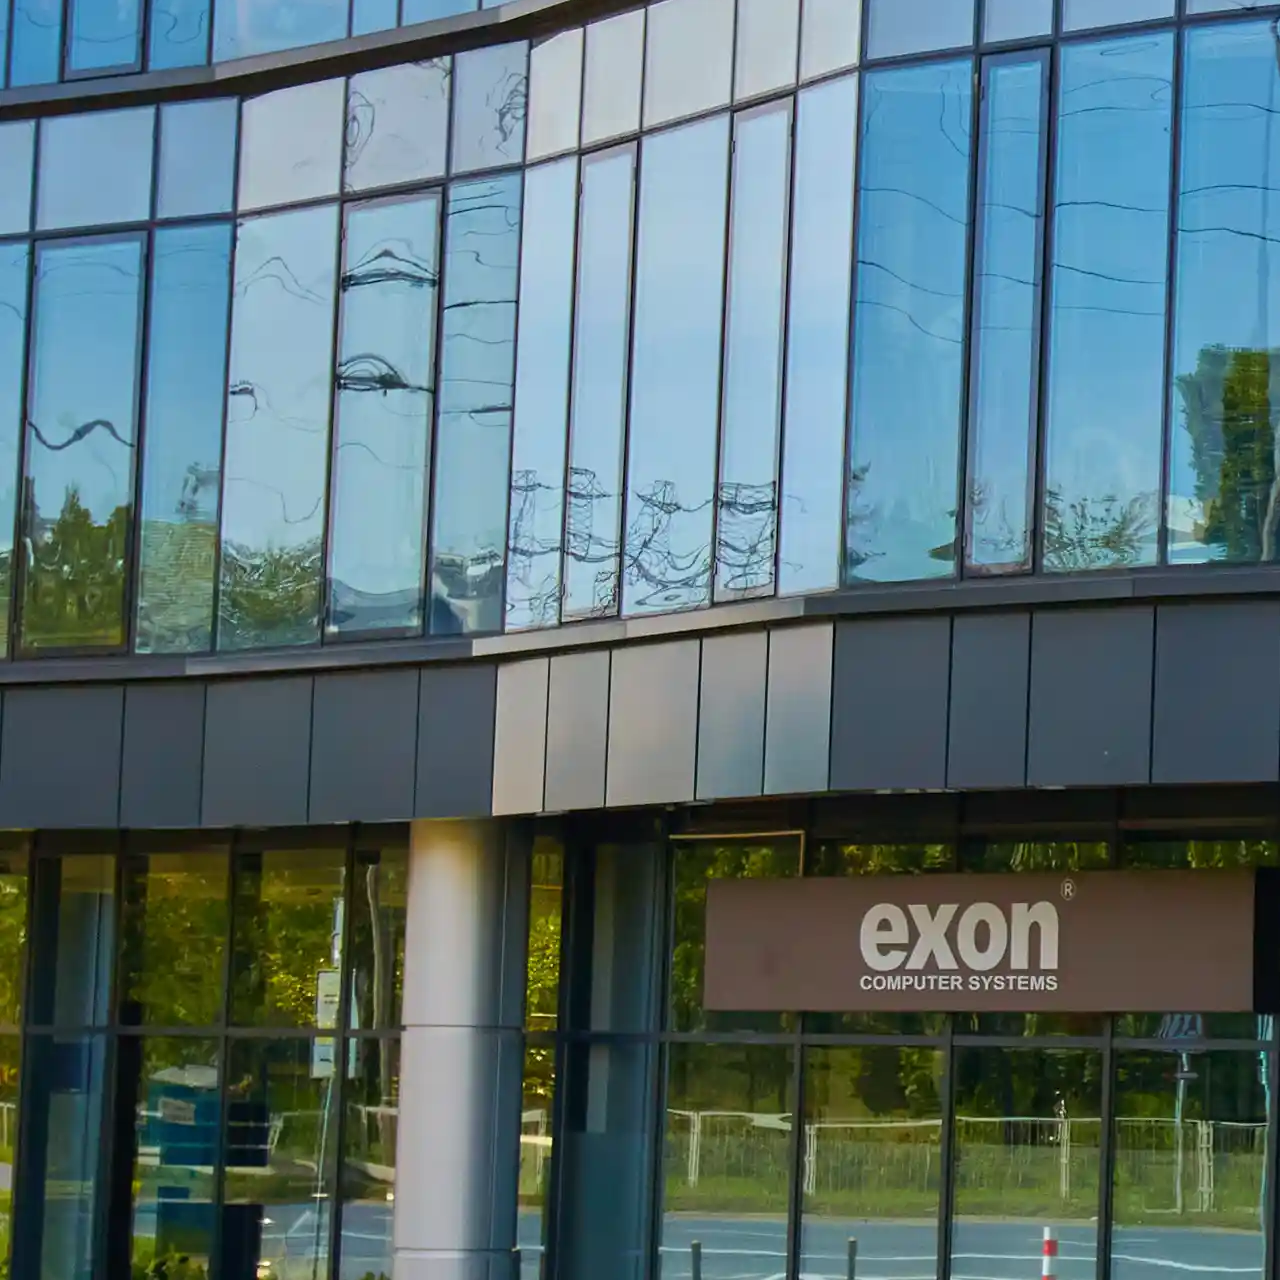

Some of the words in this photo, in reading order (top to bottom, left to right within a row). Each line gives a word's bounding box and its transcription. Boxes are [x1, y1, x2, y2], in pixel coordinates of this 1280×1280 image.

[860, 901, 1059, 971] exon
[860, 975, 963, 990] COMPUTER
[968, 975, 1058, 990] SYSTEMS
